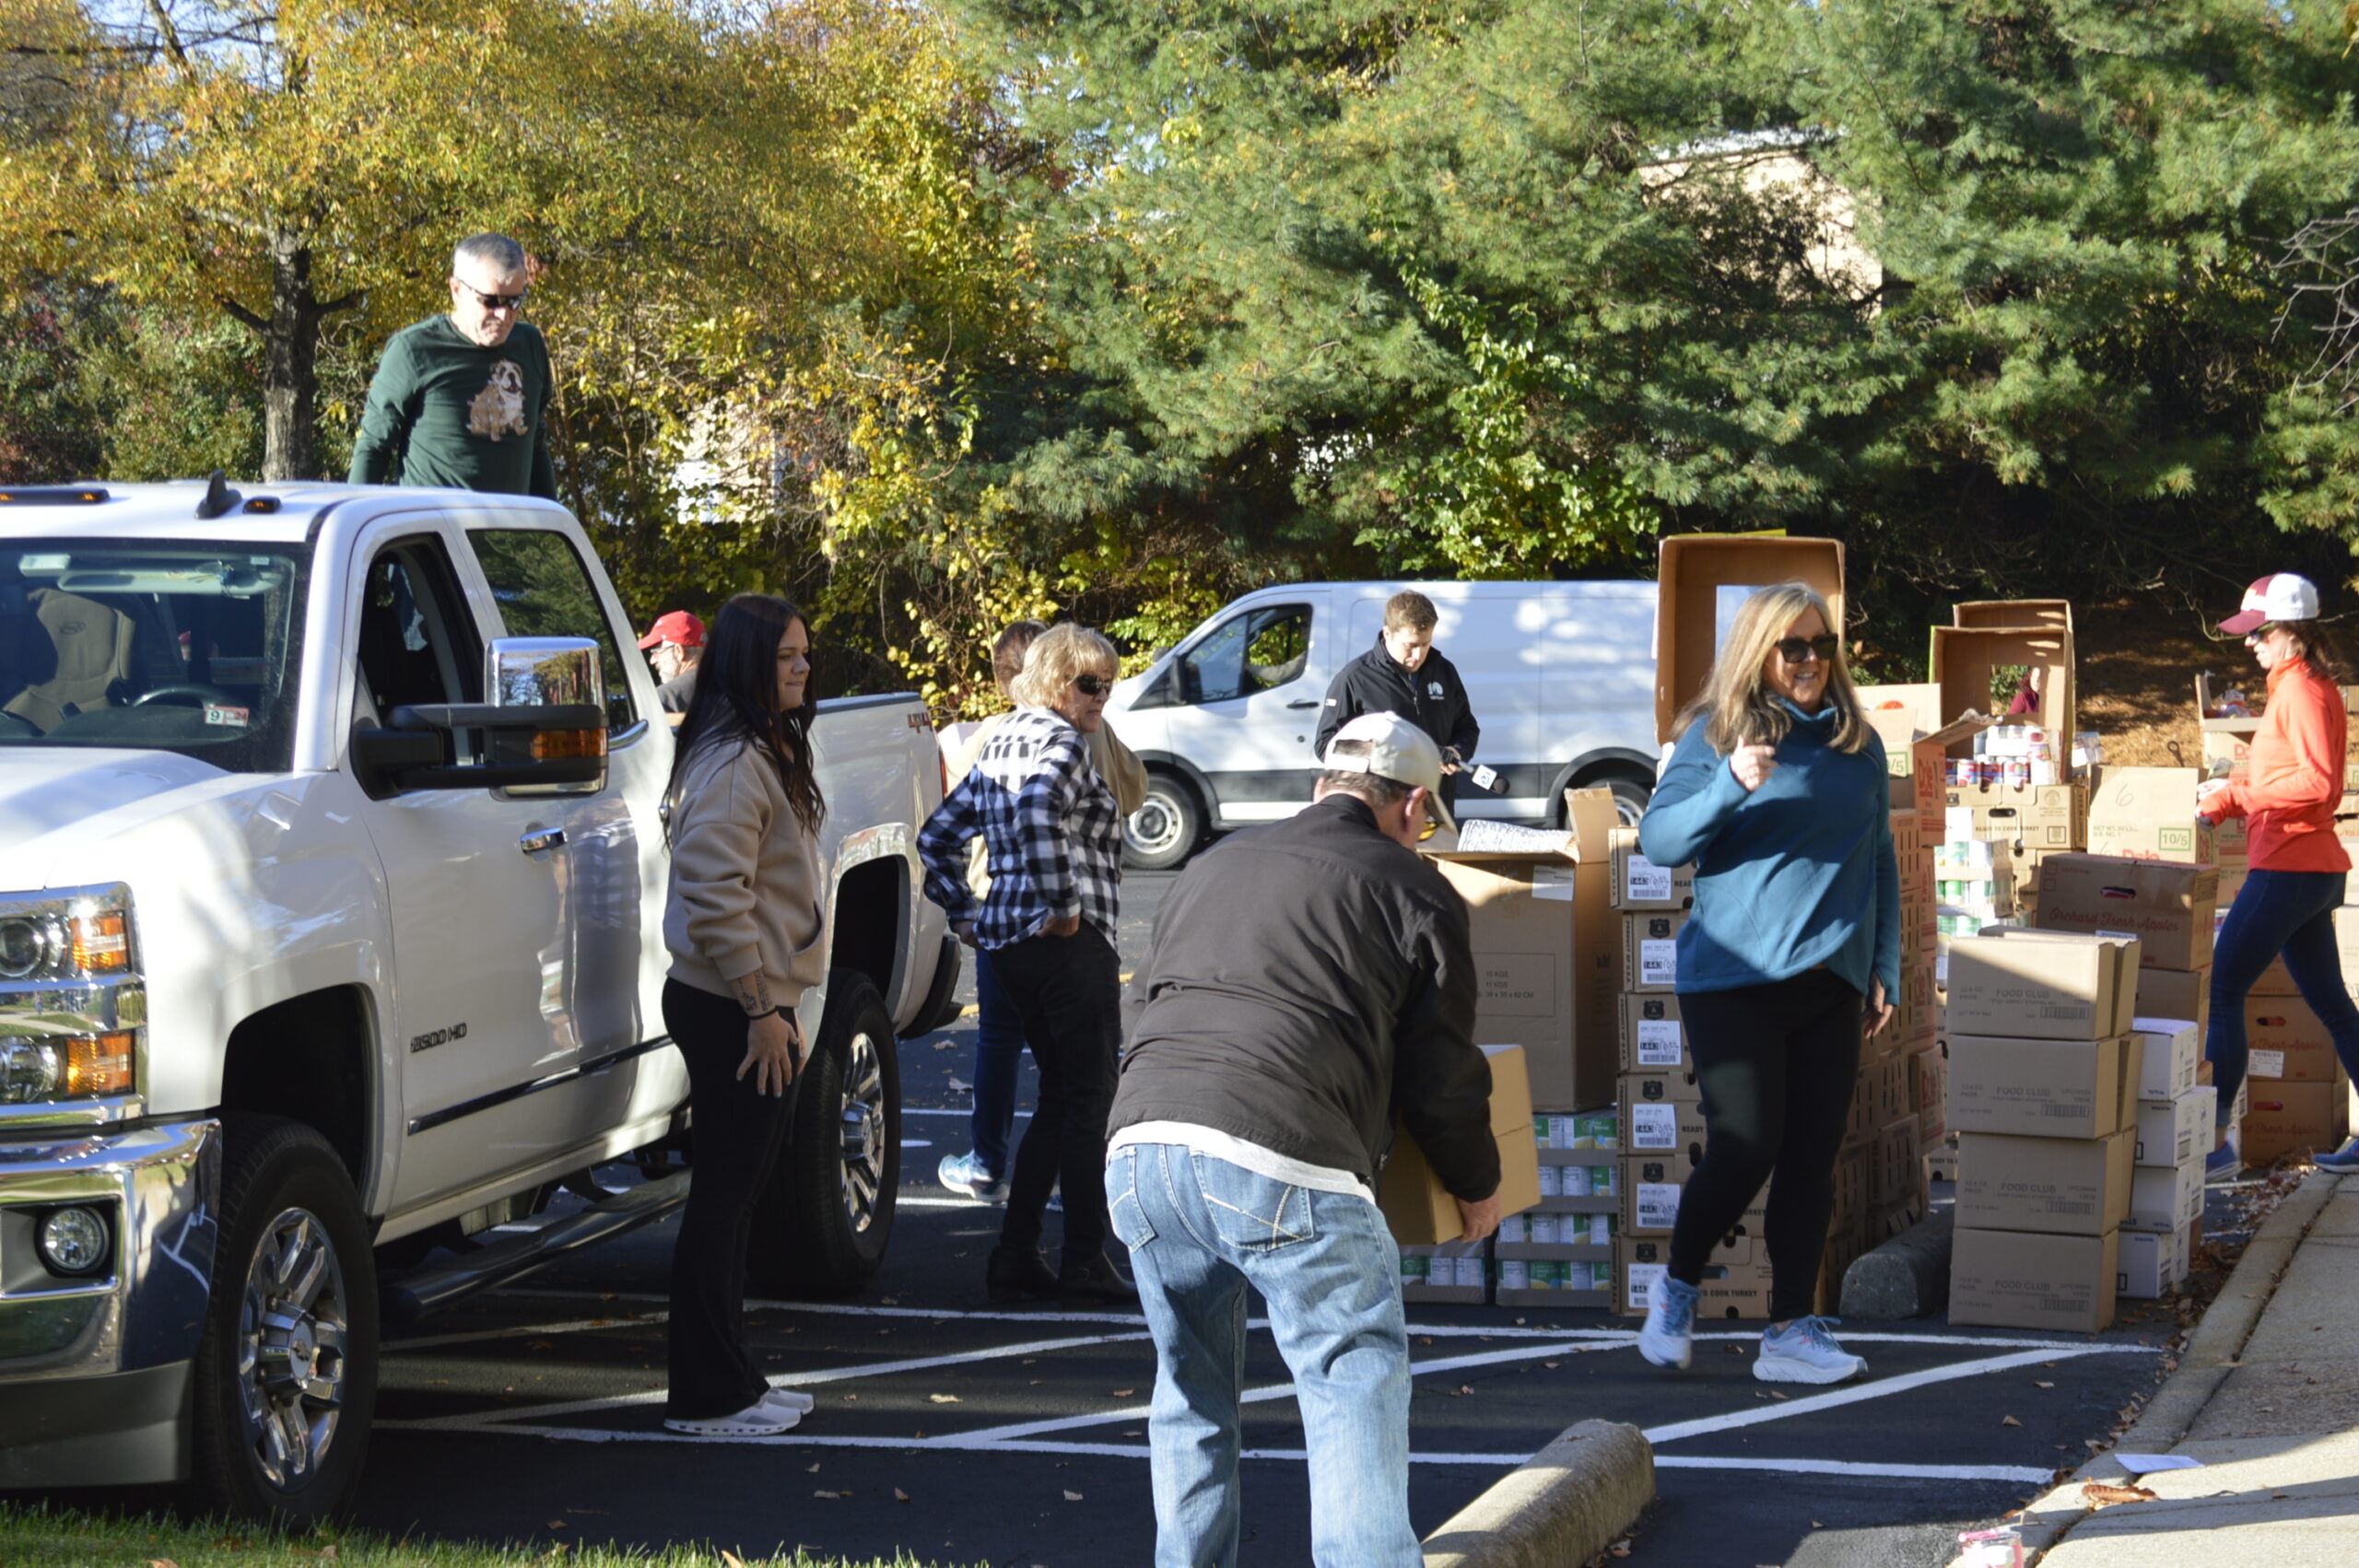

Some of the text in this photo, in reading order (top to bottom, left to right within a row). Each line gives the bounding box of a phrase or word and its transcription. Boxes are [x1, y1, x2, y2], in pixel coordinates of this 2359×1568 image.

[210, 710, 220, 721] 9
[2162, 833, 2189, 847] 10/5
[2048, 907, 2098, 923] Orchard
[2101, 911, 2137, 928] Fresh
[1996, 989, 2050, 1000] FOOD CLUB
[447, 1022, 467, 1043] HD
[1996, 1086, 2024, 1095] FOOD
[1682, 1125, 1704, 1133] READY
[2001, 1182, 2057, 1194] FOOD CLUB
[1744, 1208, 1766, 1216] URKEY
[1994, 1280, 2023, 1290] FOOD
[1731, 1290, 1757, 1298] TURKEY
